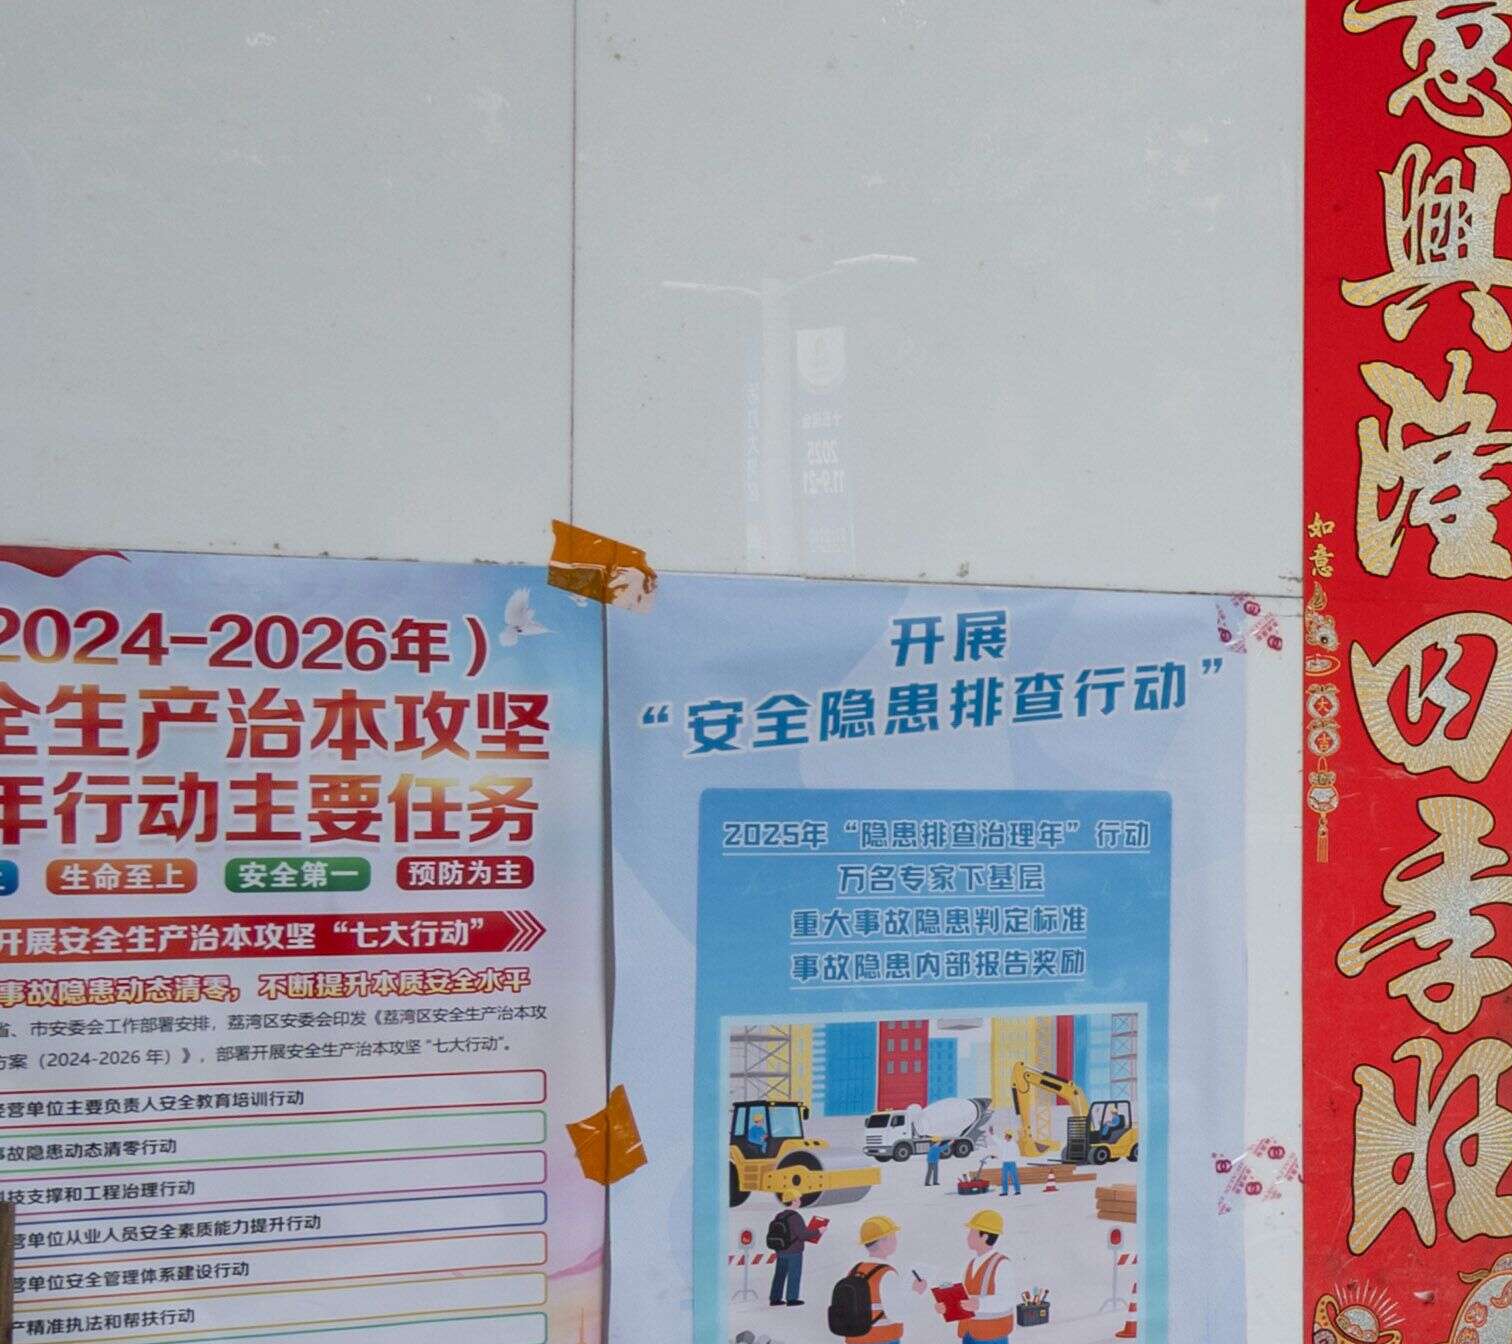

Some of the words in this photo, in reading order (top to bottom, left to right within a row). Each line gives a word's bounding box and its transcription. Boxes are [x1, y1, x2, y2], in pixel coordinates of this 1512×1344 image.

[890, 609, 1007, 668] 开展
[60, 861, 186, 891] 生命至上
[238, 860, 360, 889] 安全第一
[408, 859, 523, 887] 预防为主
[837, 863, 1045, 894] 万名专家下基层
[791, 906, 1087, 940] 重大事故隐患判定标准
[791, 947, 1086, 982] 事故隐患内部报告奖励
